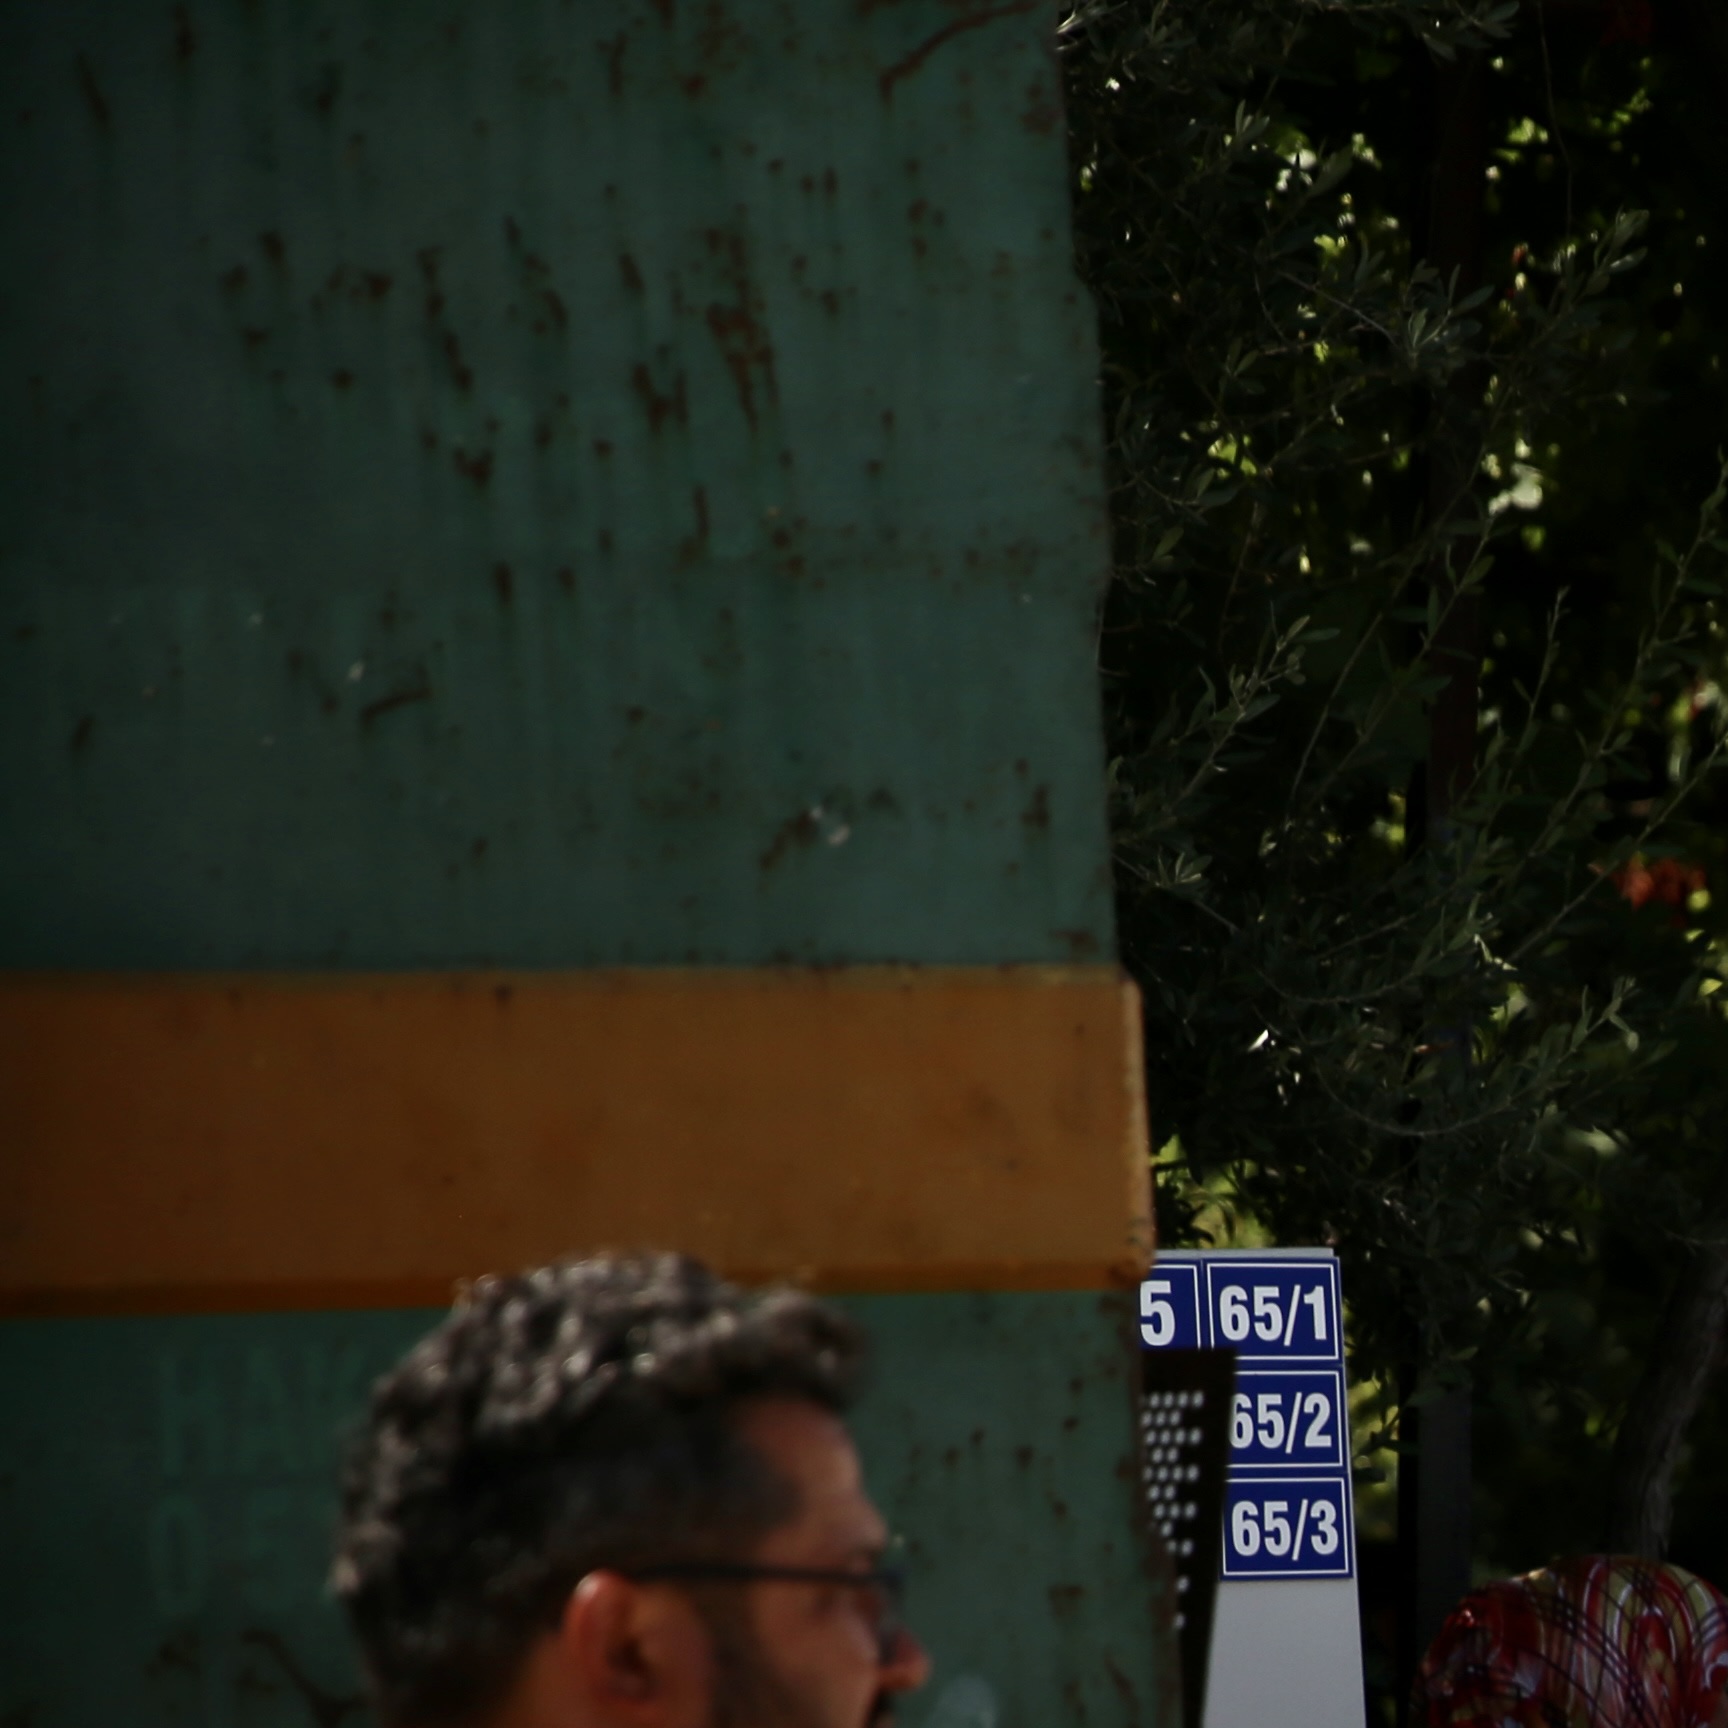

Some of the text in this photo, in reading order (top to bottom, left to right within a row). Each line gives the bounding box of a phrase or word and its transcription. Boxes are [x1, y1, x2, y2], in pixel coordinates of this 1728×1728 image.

[1218, 1284, 1328, 1347] 65/1
[1229, 1391, 1333, 1454] 65/2
[1231, 1499, 1339, 1561] 65/3
